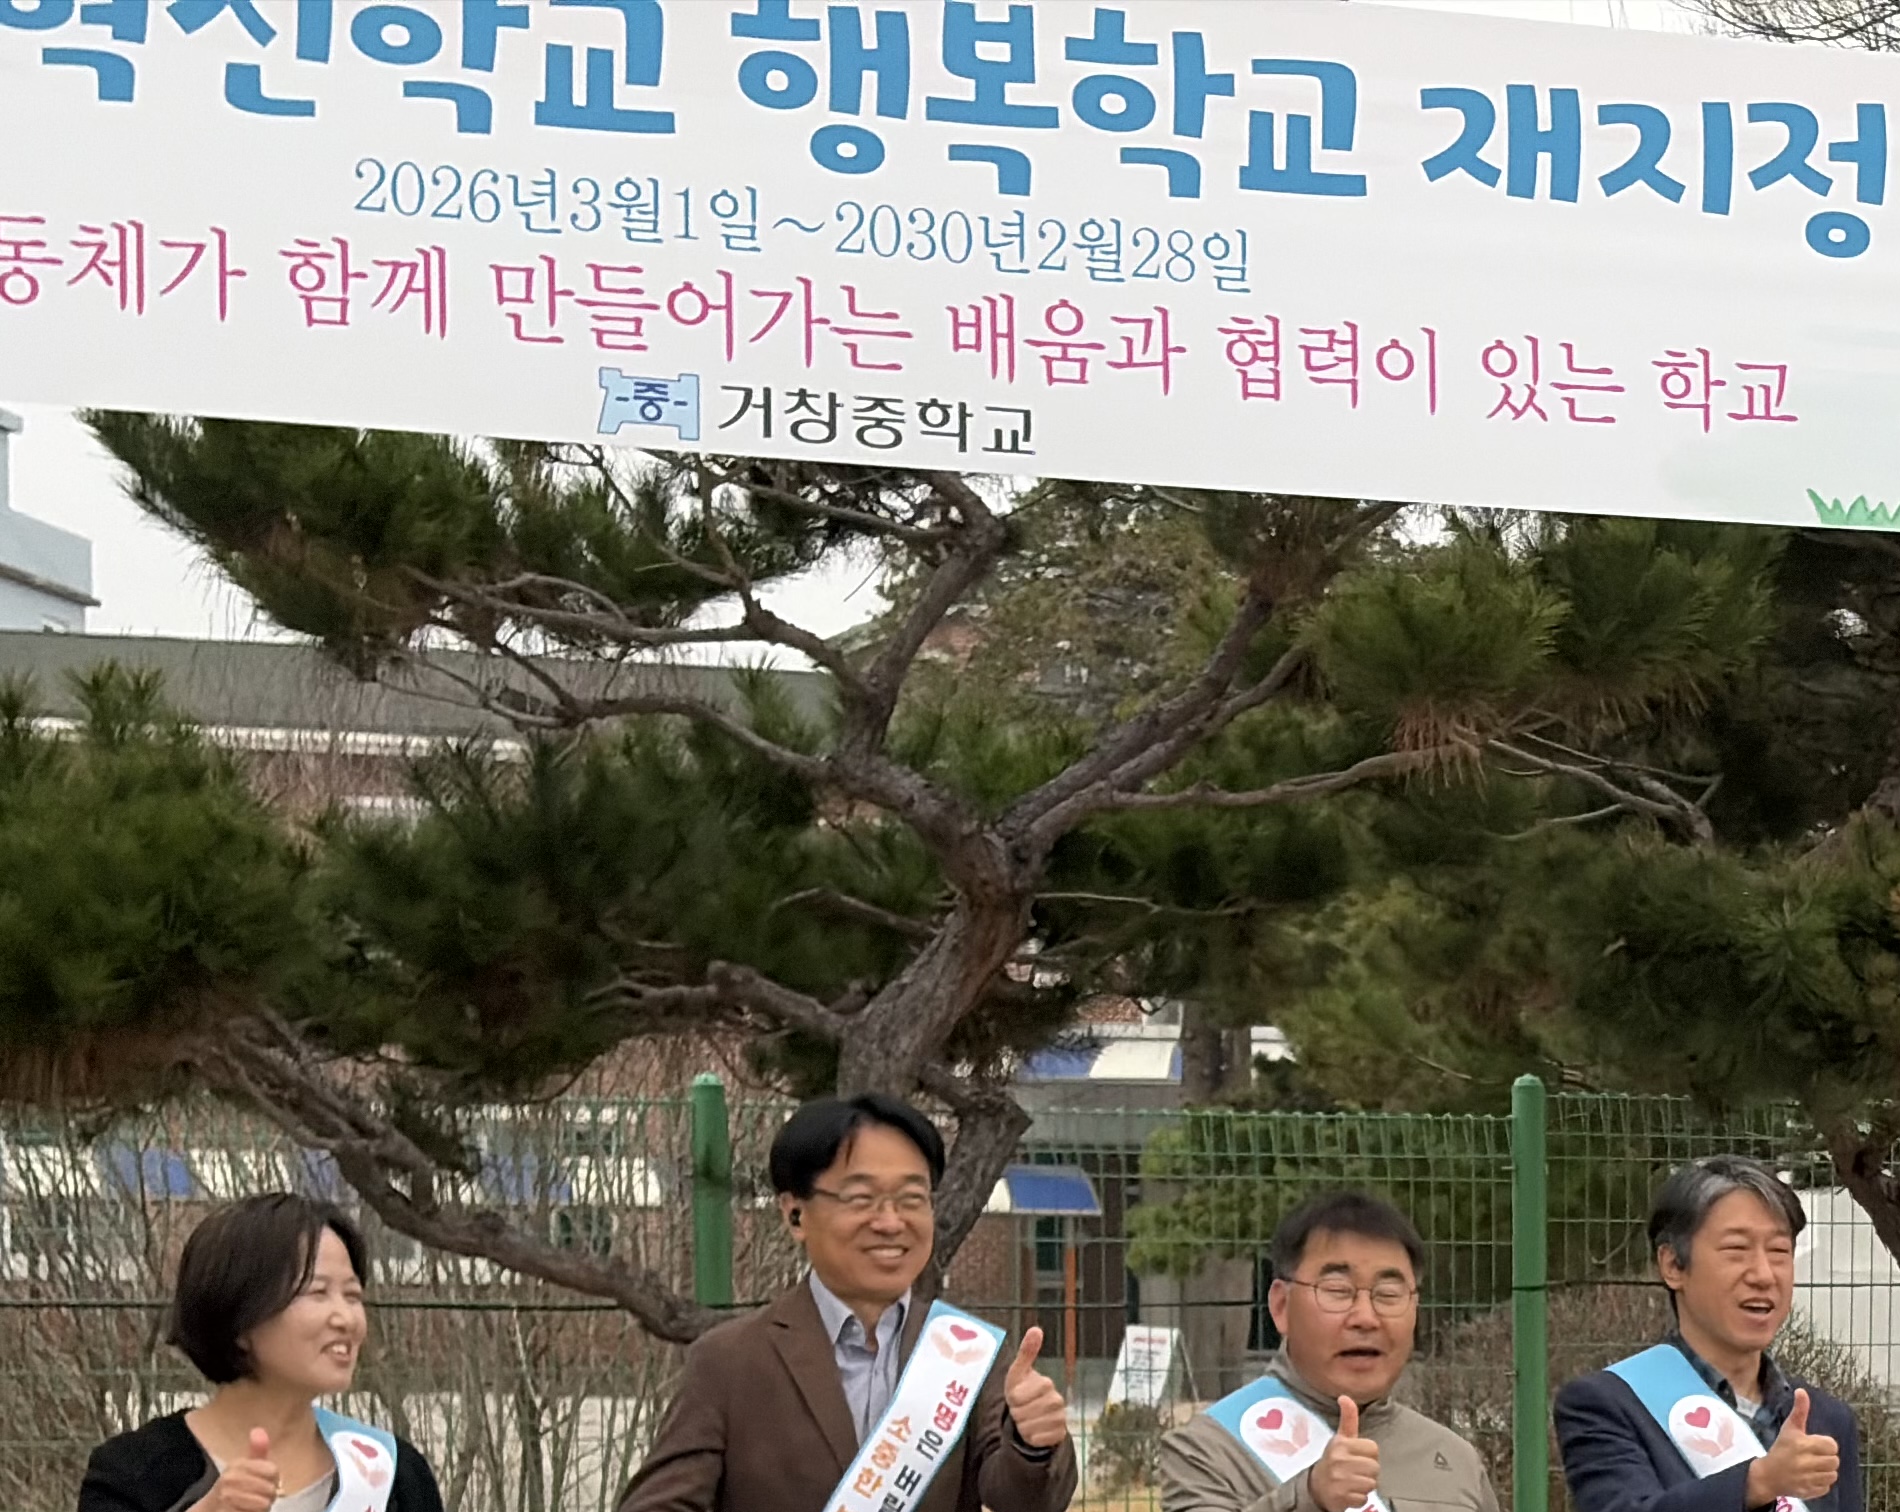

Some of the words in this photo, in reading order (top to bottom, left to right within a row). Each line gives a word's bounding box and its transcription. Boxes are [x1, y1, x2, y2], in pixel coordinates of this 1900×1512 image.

[728, 0, 1367, 199] 행복학교
[1420, 84, 1887, 258] 재지정
[279, 237, 447, 340] 함께
[489, 254, 914, 371] 만들어가는
[946, 293, 1187, 396] 배움과
[1217, 314, 1437, 415] 협력이
[1482, 334, 1625, 423] 있는
[1652, 348, 1799, 433] 학교
[718, 385, 1036, 456] 거창중학교
[854, 1416, 913, 1499] 소중한
[915, 1379, 970, 1461] 생명은
